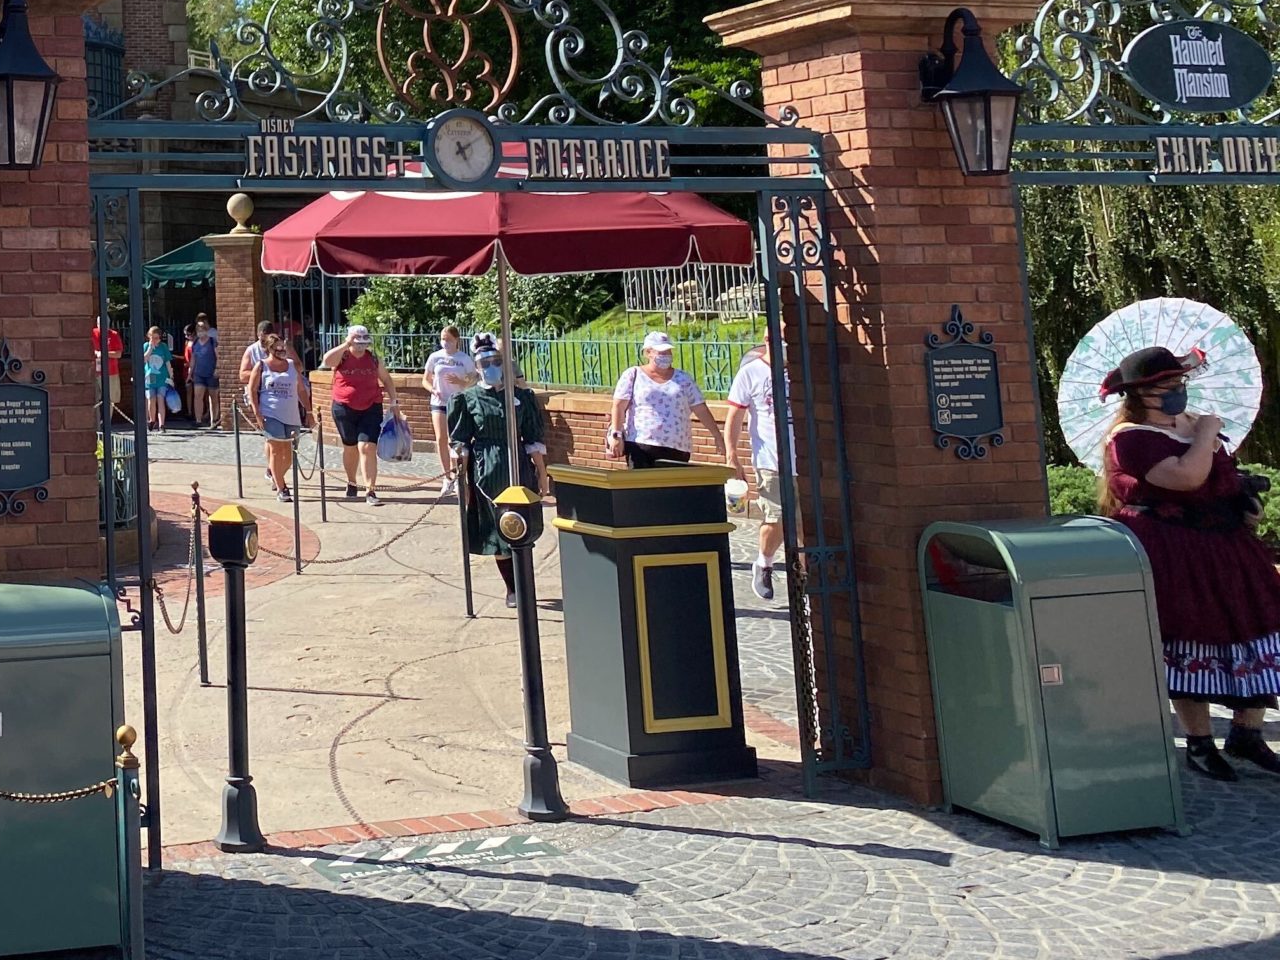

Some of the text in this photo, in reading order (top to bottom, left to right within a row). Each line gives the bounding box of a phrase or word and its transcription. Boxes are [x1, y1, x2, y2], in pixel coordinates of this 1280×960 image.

[1185, 25, 1202, 39] The
[1169, 33, 1226, 66] Haunted
[1173, 67, 1231, 103] Mansion
[261, 119, 295, 133] DISNEY
[528, 138, 670, 178] ENTRANCE
[1156, 137, 1278, 173] EXIT ONLY
[446, 851, 494, 859] SAFETY
